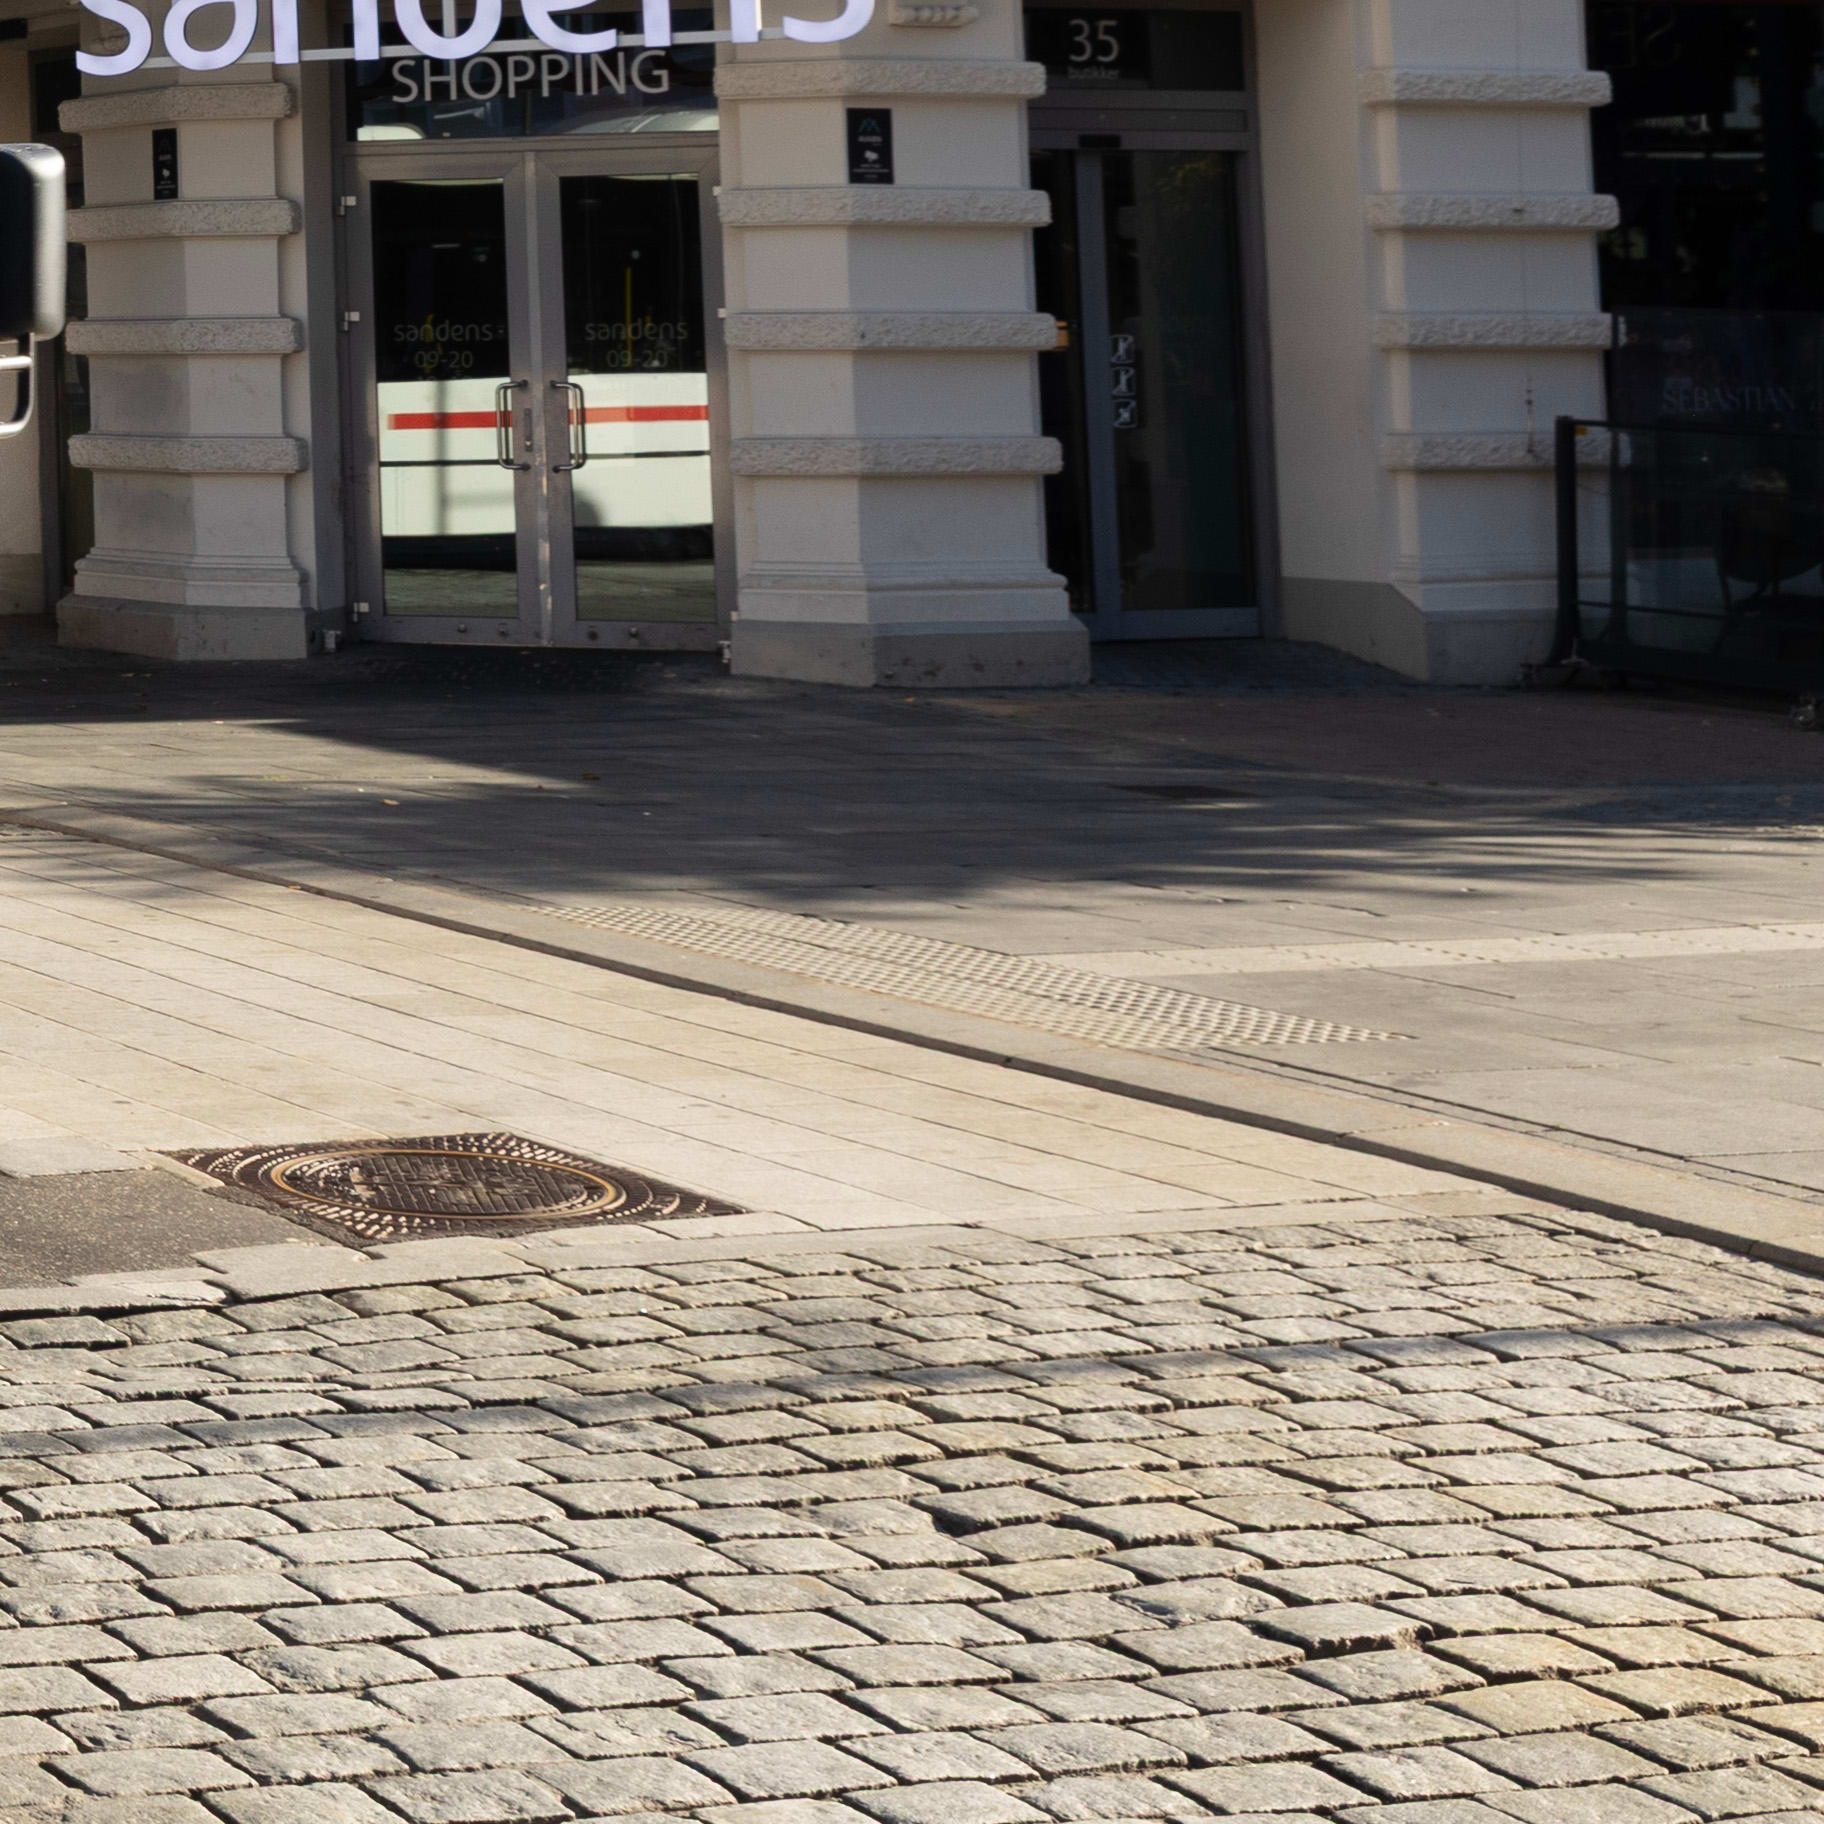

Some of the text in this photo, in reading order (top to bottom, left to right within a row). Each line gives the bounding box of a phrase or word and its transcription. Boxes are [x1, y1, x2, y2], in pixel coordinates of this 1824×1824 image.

[1069, 19, 1120, 63] 35
[392, 49, 670, 103] SHOPPING
[393, 317, 494, 343] sandens
[583, 317, 689, 343] sandens
